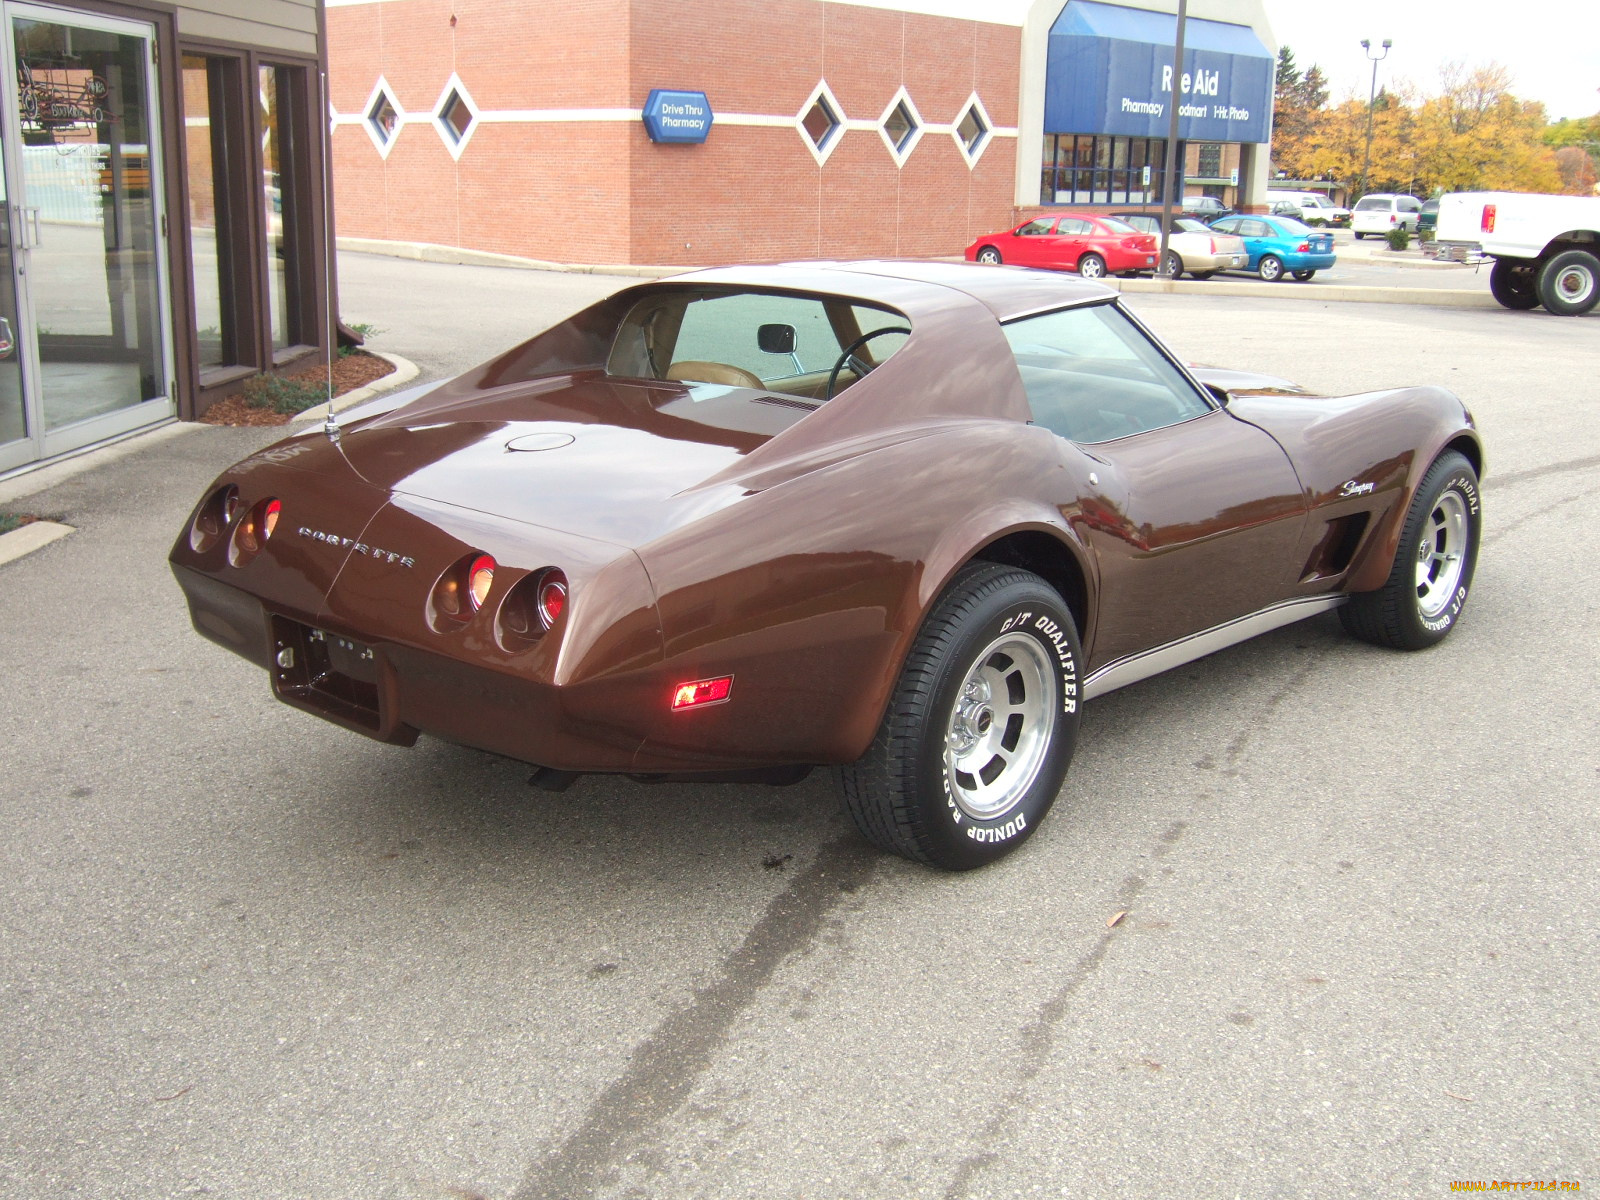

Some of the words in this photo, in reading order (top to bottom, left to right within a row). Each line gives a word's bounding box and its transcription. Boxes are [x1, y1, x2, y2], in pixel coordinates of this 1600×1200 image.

[1162, 65, 1191, 94] Re
[1193, 69, 1219, 96] Aid
[662, 103, 684, 115] Drive
[685, 104, 703, 115] Thru
[662, 116, 704, 130] Pharmacy
[1122, 98, 1164, 117] Pharmacy
[1177, 103, 1207, 118] odmart
[1229, 106, 1249, 120] Photo
[1457, 477, 1479, 515] RADIAL
[299, 526, 415, 568] CORVETTE
[1452, 586, 1466, 615] G/T
[1000, 612, 1032, 633] G/T
[1034, 615, 1077, 713] QUALIFIER
[967, 812, 1027, 843] DUNLOP
